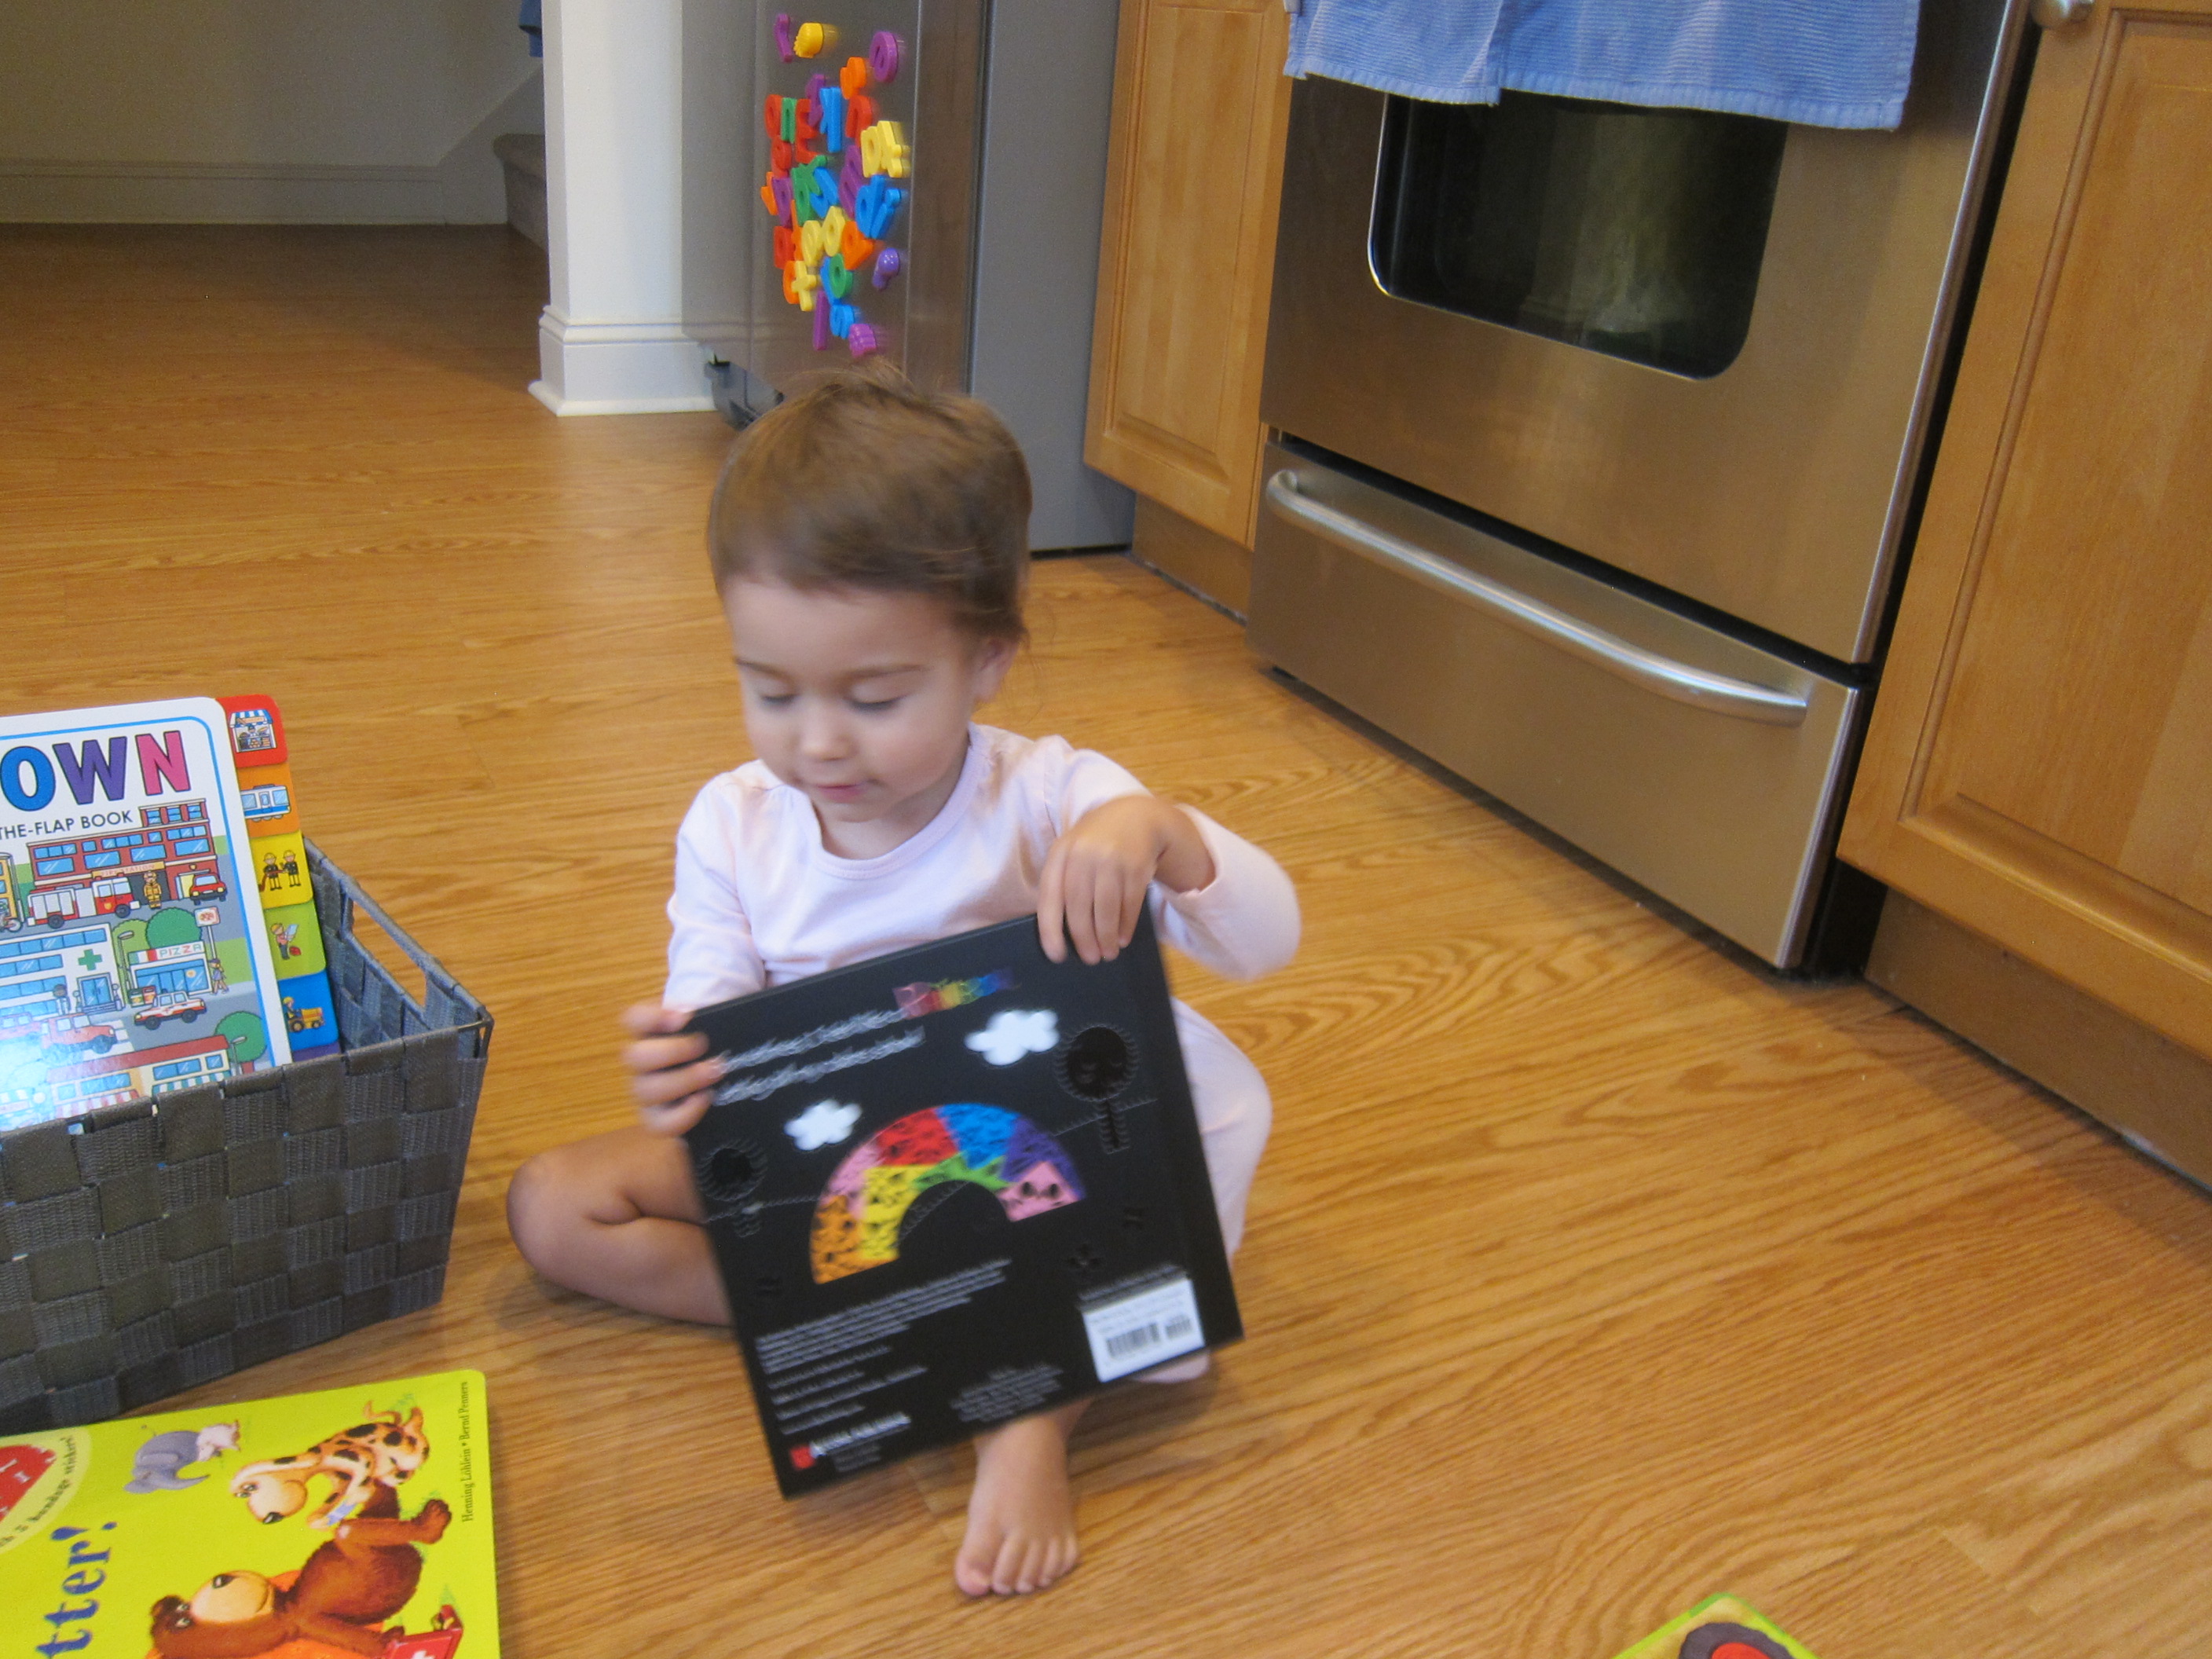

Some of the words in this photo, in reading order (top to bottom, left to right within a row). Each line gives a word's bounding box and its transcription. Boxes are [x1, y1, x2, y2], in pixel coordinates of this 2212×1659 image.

[0, 730, 191, 811] OWN
[80, 810, 133, 830] BOOK
[159, 943, 202, 958] PIZZA
[458, 1381, 469, 1414] Penners
[458, 1415, 471, 1441] Bernd
[461, 1482, 475, 1522] Henning
[35, 1522, 119, 1659] tter!
